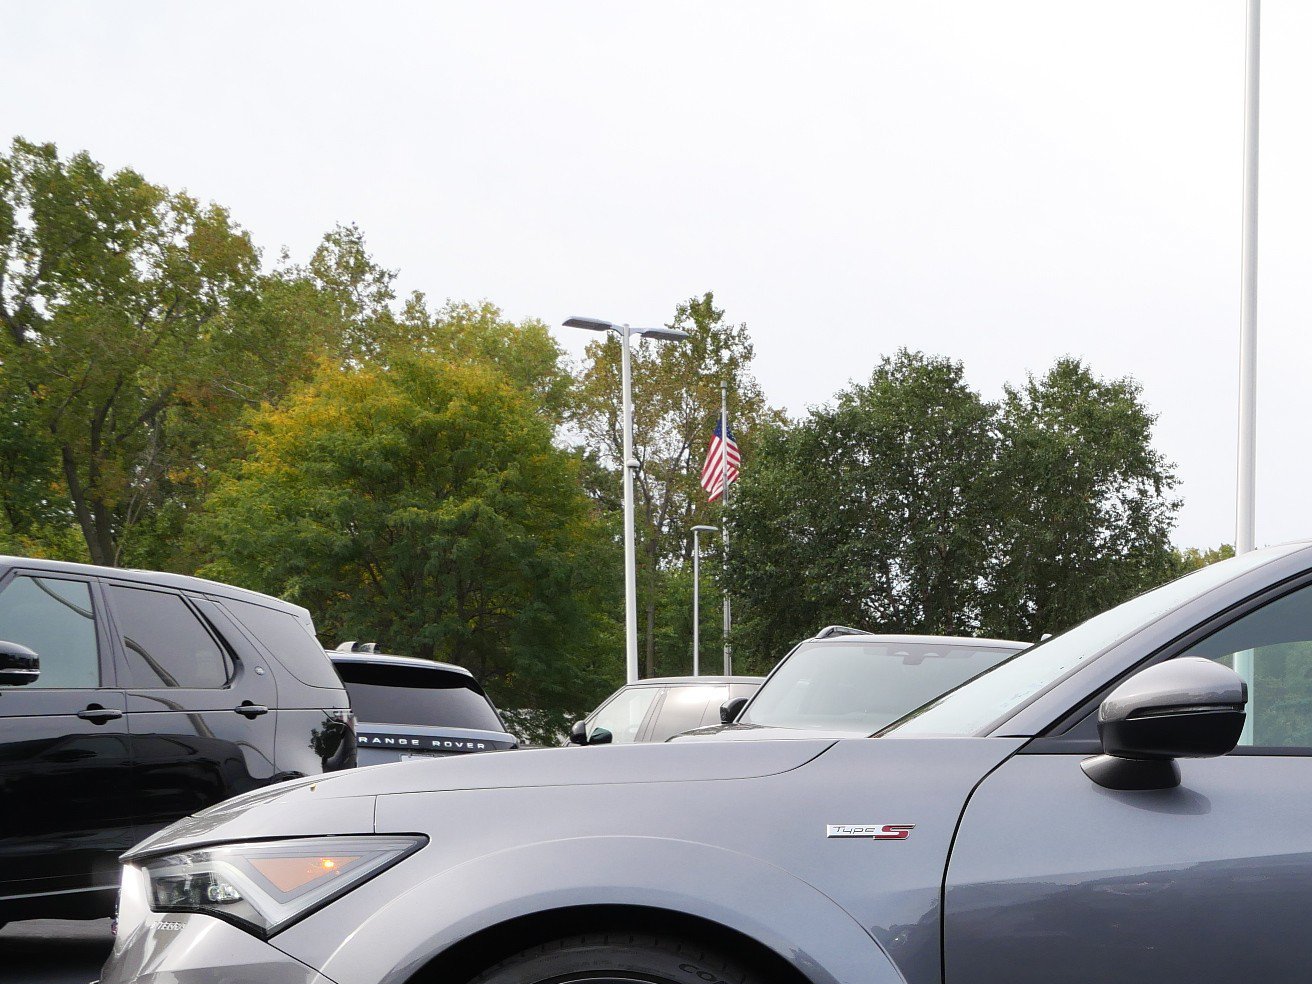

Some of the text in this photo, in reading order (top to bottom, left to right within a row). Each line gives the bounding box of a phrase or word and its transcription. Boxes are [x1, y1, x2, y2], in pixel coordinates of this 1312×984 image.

[358, 736, 485, 749] RANGE ROVER
[832, 823, 916, 840] Type S
